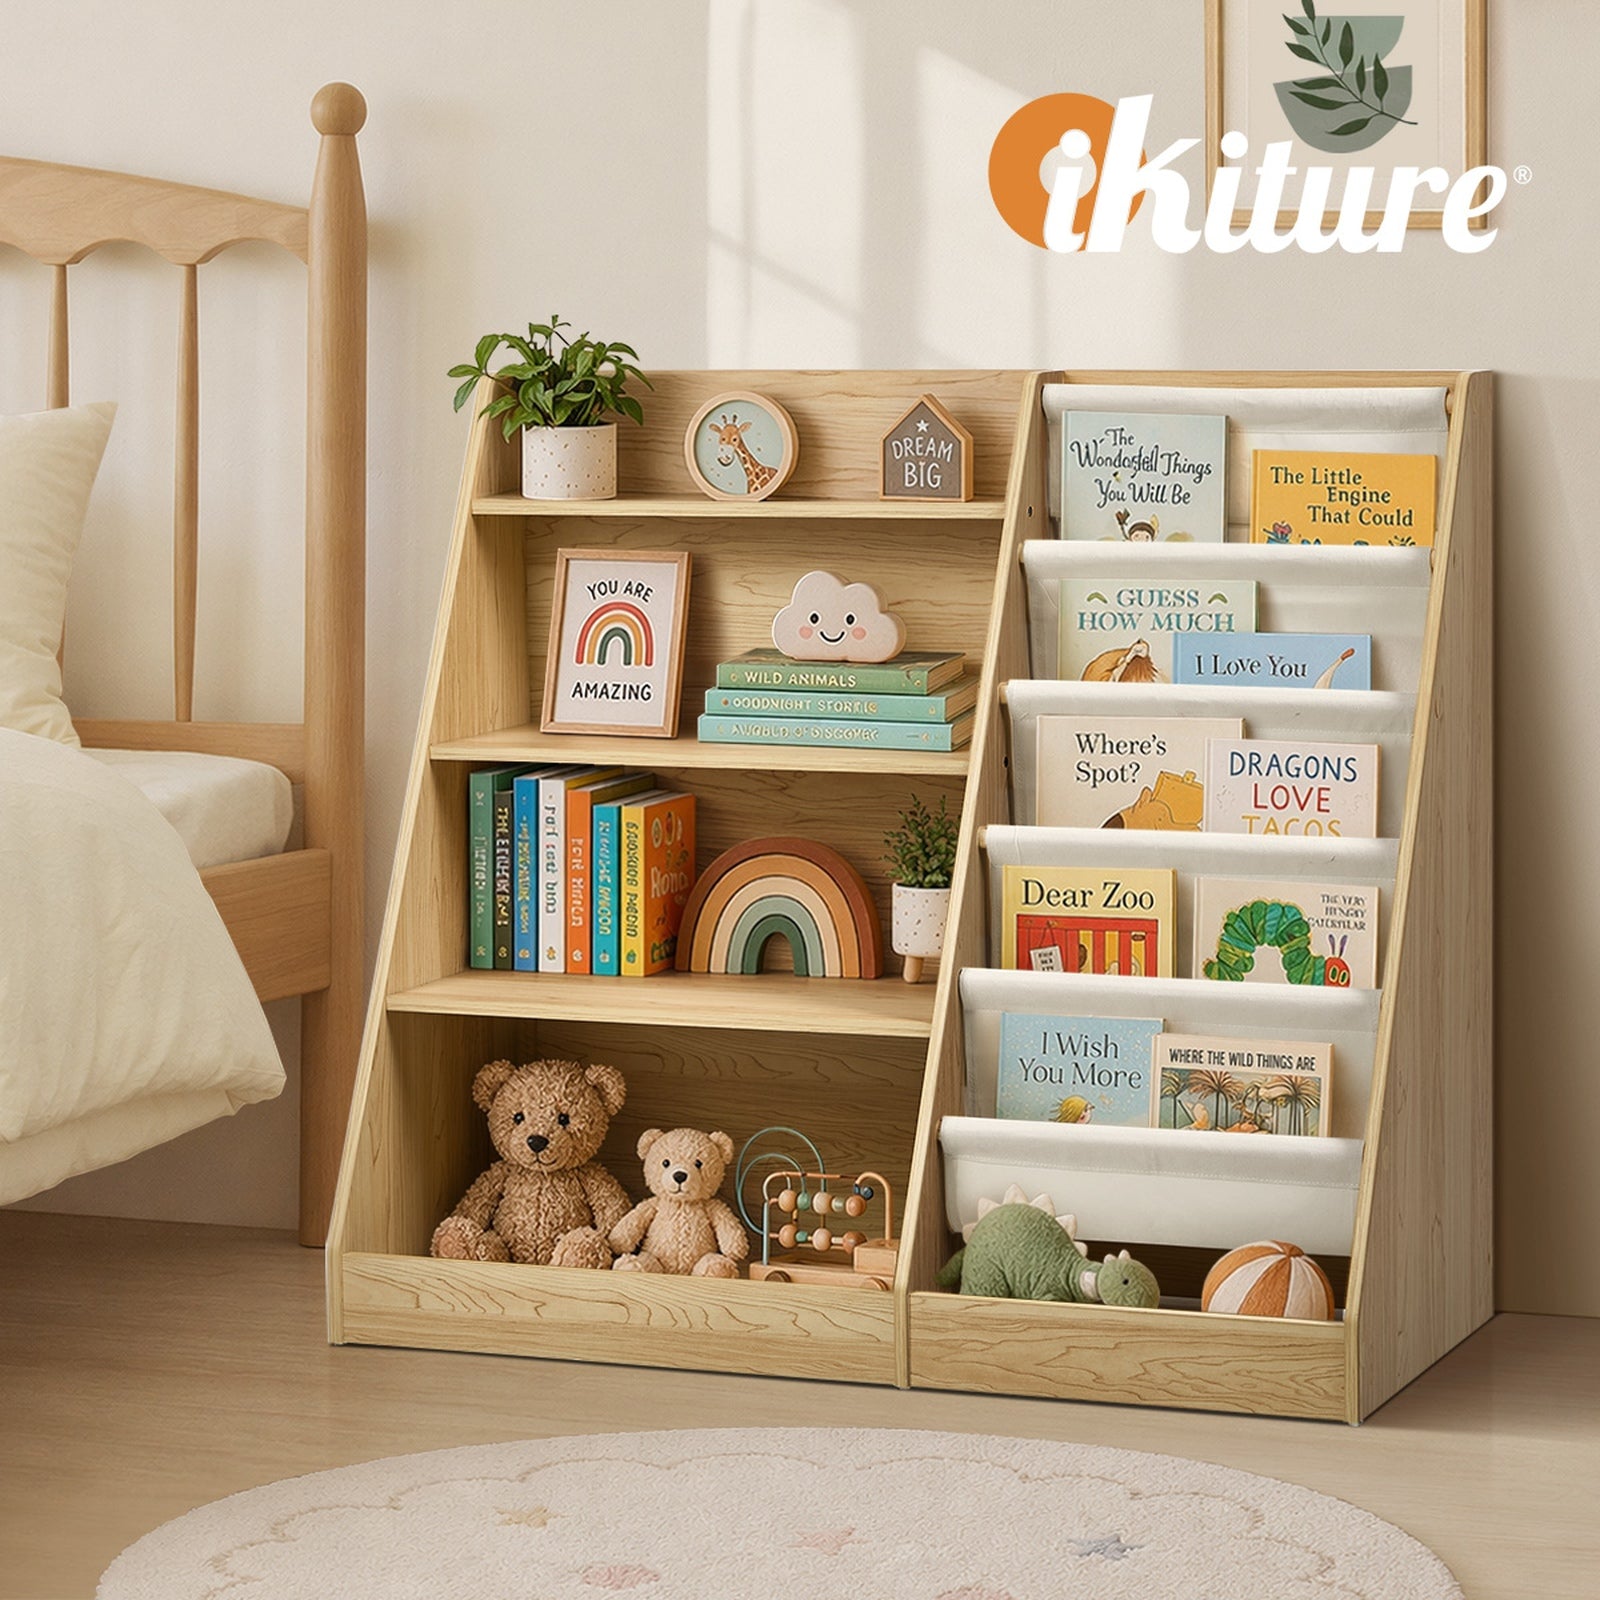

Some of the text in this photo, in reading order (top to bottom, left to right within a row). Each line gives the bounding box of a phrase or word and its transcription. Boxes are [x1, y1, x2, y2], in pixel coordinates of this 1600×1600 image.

[1105, 427, 1135, 446] The
[892, 436, 953, 463] DREAM
[904, 461, 942, 489] BIG
[1160, 451, 1213, 485] Things
[1270, 466, 1362, 486] The Little
[1094, 477, 1191, 509] You Will Be
[1327, 486, 1391, 506] Engine
[1307, 505, 1413, 527] That Could
[587, 580, 653, 603] YOU ARE
[1116, 588, 1200, 608] GUESS
[1077, 611, 1236, 633] HOW MUCH
[1195, 654, 1309, 678] I Love You
[571, 682, 652, 701] AMAZING
[744, 671, 857, 688] WILD ANIMALS
[1075, 733, 1167, 756] Where's
[1076, 761, 1141, 788] Spot?
[1230, 751, 1358, 783] DRAGONS
[1253, 783, 1332, 813] LOVE
[1241, 815, 1342, 837] TACOS
[1022, 879, 1155, 911] Dear Zoo
[1041, 1031, 1120, 1060] I Wish
[1169, 1048, 1317, 1072] WHERE THE WILD THINGS ARE
[1019, 1058, 1143, 1090] You More
